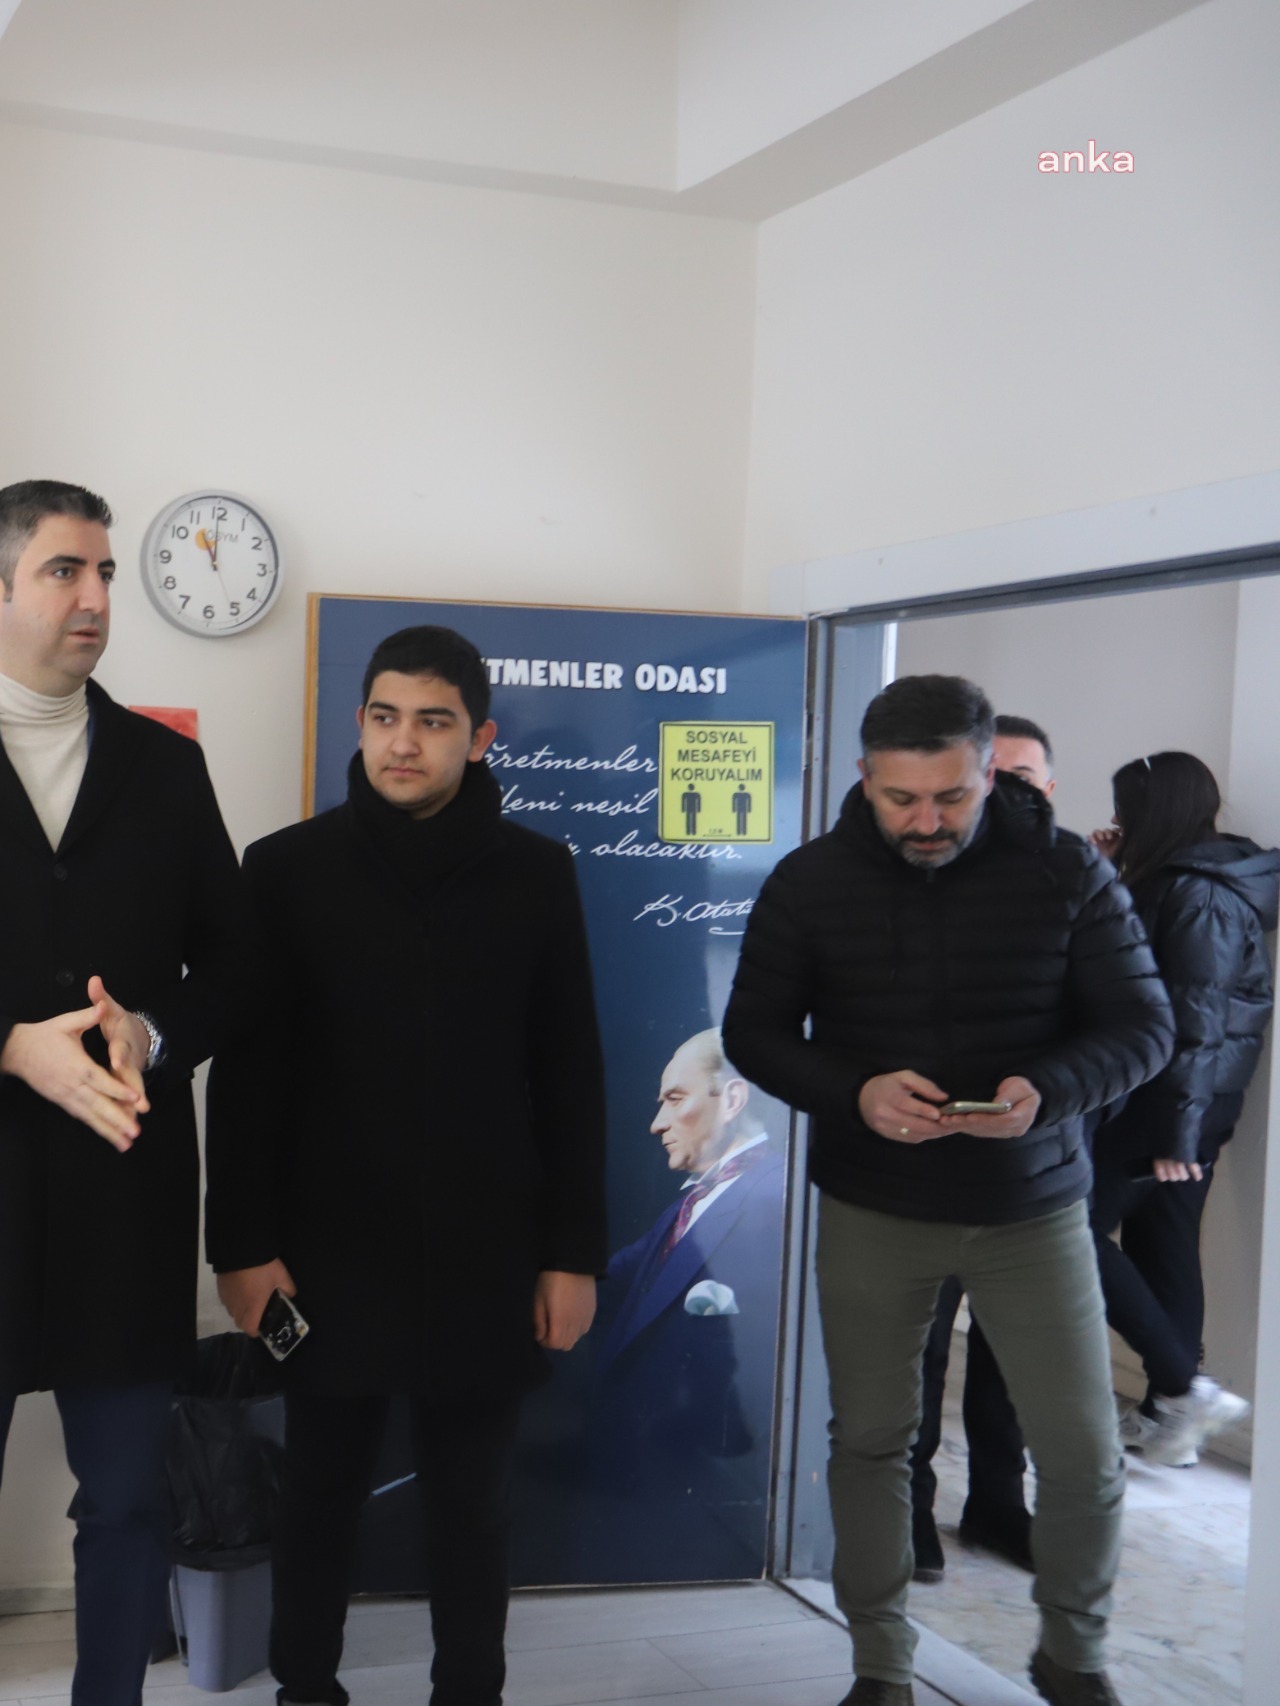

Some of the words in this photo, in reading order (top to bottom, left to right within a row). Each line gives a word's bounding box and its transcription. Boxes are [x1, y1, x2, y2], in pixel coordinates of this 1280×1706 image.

[190, 510, 201, 525] 11
[212, 506, 228, 521] 12
[171, 524, 189, 540] 10
[251, 536, 263, 551] 2
[159, 549, 172, 564] 9
[256, 563, 267, 577] 3
[163, 576, 177, 590] 8
[246, 587, 257, 601] 4
[178, 594, 191, 610] 7
[229, 602, 240, 616] 5
[202, 605, 215, 619] 6
[481, 658, 623, 690] TMENLER
[634, 663, 727, 694] ODASI
[686, 730, 748, 744] SOSYAL
[677, 746, 757, 762] MESAFEYİ
[670, 767, 763, 781] KORUYALIM
[570, 788, 659, 816] nesil
